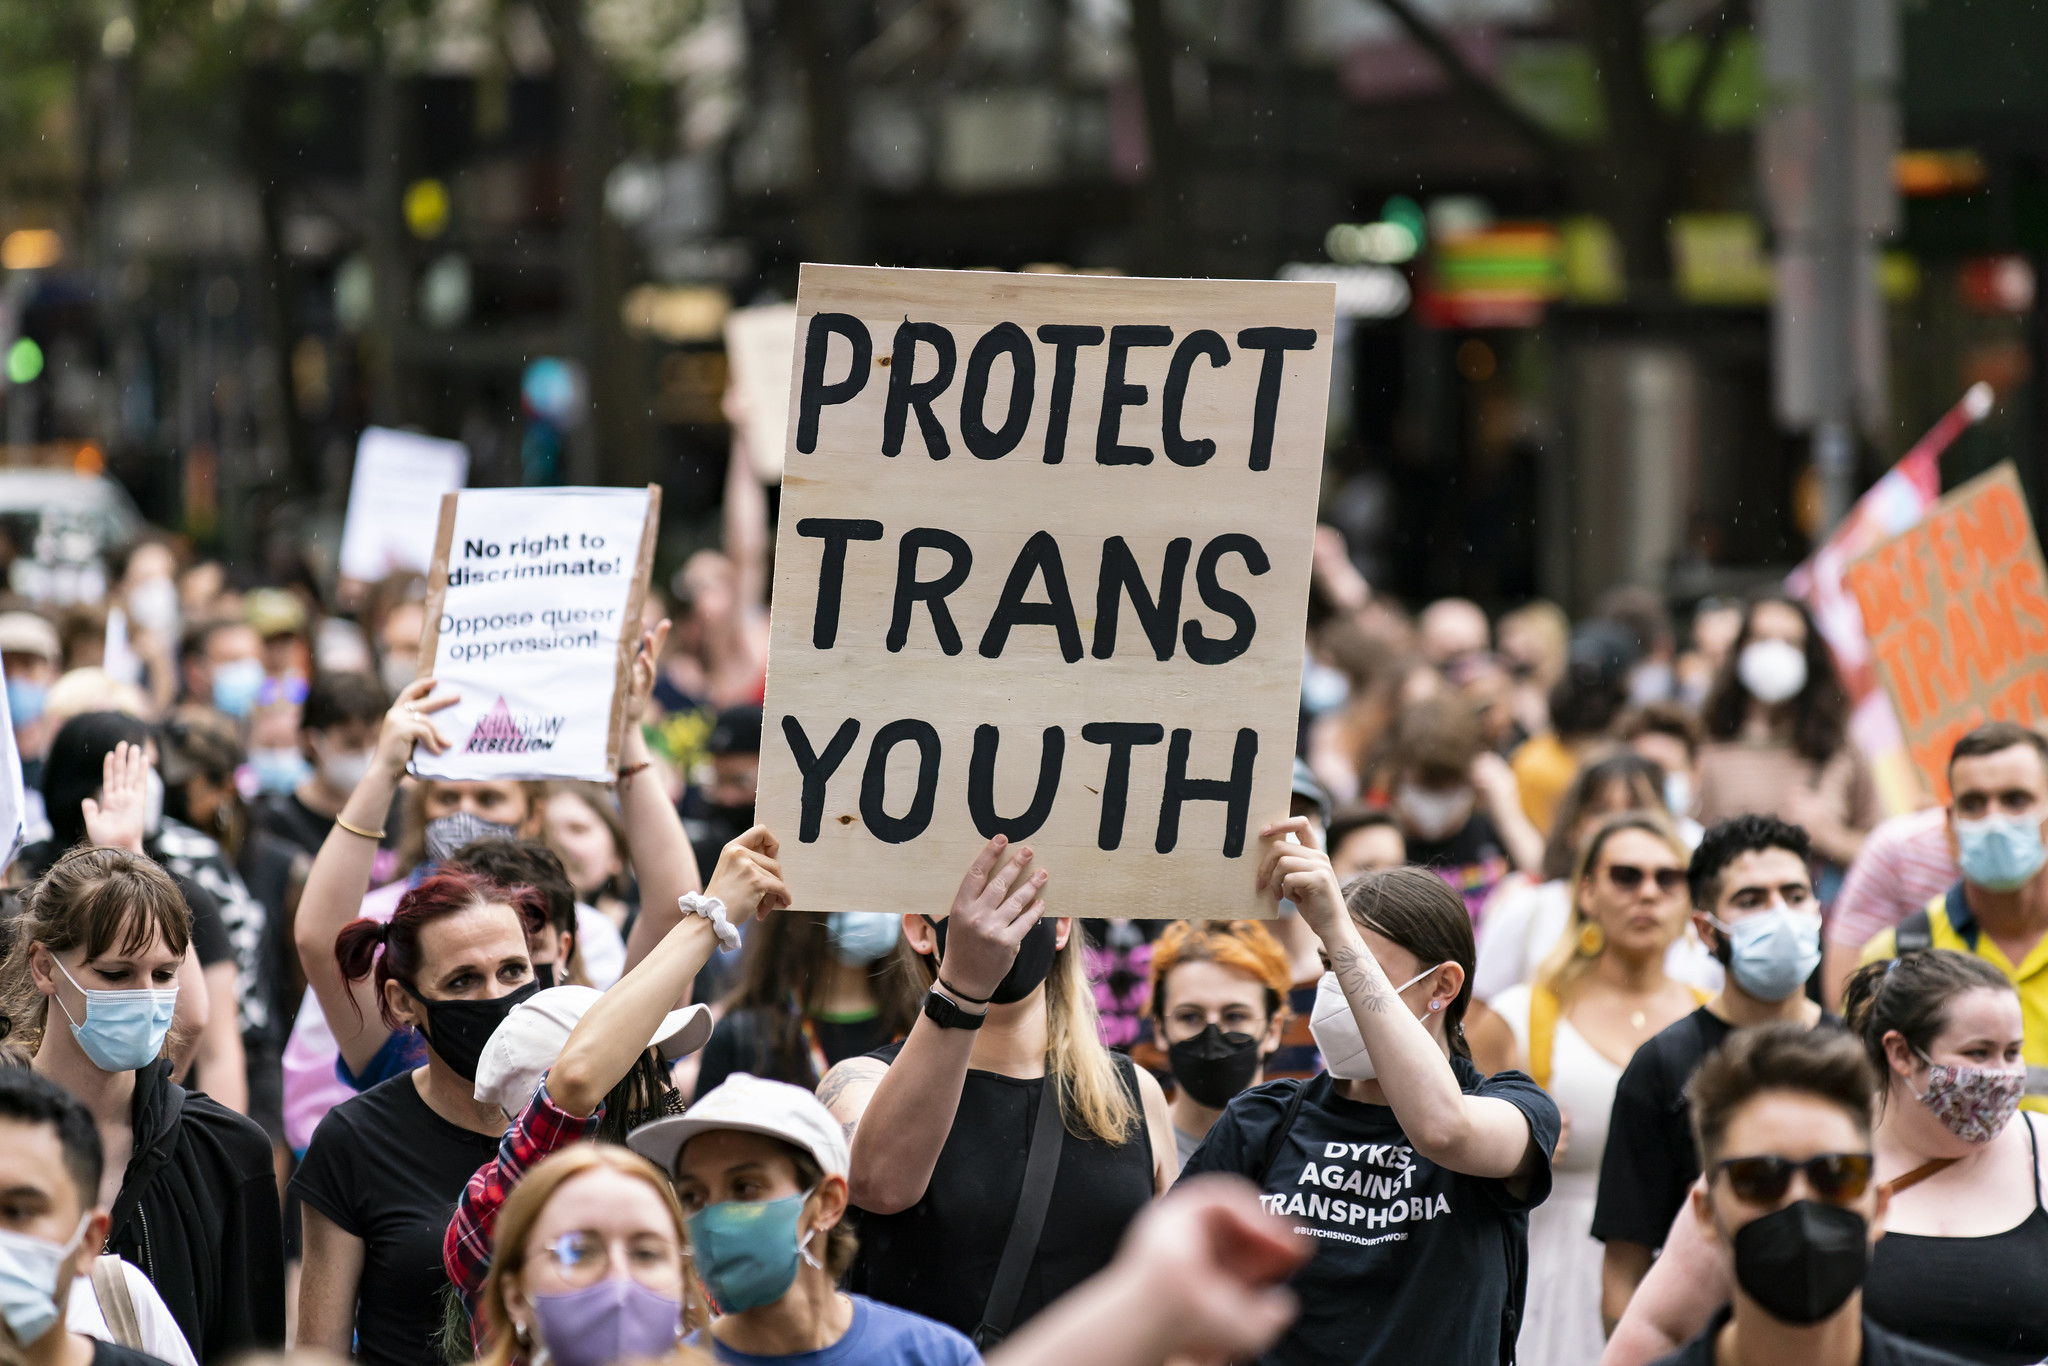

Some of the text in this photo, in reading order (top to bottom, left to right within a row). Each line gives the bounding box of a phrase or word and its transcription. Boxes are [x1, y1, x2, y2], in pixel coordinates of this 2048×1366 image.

[796, 311, 1317, 471] PROTECT
[465, 532, 605, 559] No right to
[1851, 484, 2027, 636] DEFEND
[448, 556, 621, 587] discriminate!
[796, 518, 1271, 665] TRANS
[435, 607, 616, 637] Oppose queer
[450, 629, 599, 662] oppression!
[1877, 560, 2048, 729] TRANS
[466, 737, 554, 752] REBELLION
[781, 714, 1258, 858] YOUTH
[1324, 1141, 1413, 1170] DYKES
[1298, 1161, 1416, 1200] AGAINST
[1259, 1192, 1451, 1229] TRANSPHOBIA
